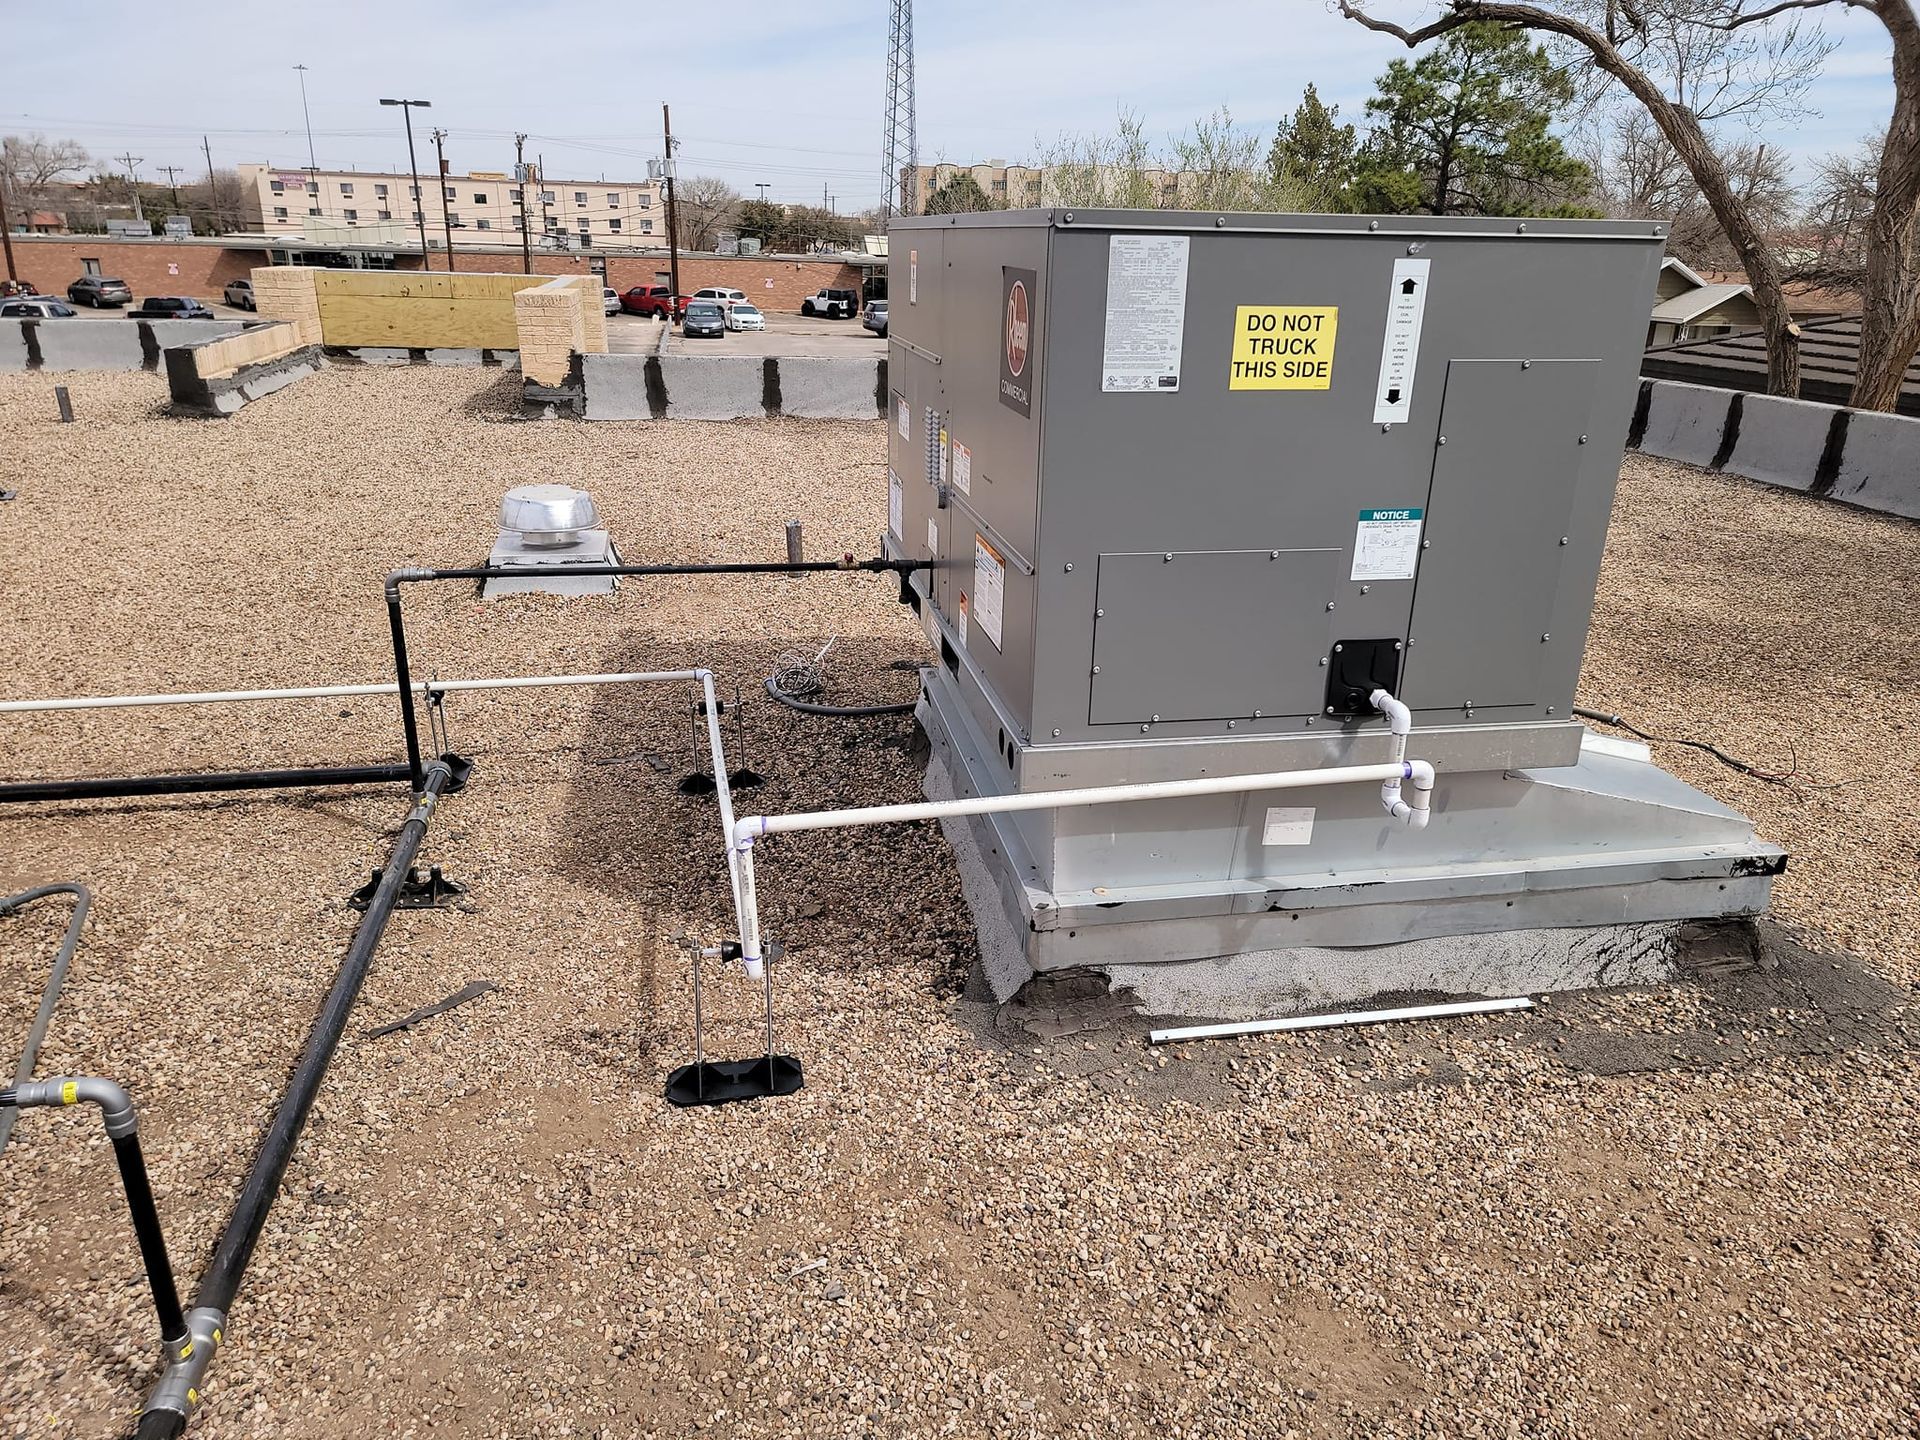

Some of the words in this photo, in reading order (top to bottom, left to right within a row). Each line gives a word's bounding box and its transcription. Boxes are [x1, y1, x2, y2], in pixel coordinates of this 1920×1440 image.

[1247, 315, 1277, 332] DO
[1282, 315, 1326, 332] NOT
[1248, 338, 1318, 355] TRUCK
[1233, 361, 1277, 378] THIS
[1282, 362, 1330, 378] SIDE
[1000, 379, 1028, 406] COMMERCIAL
[1372, 510, 1410, 520] NOTICE
